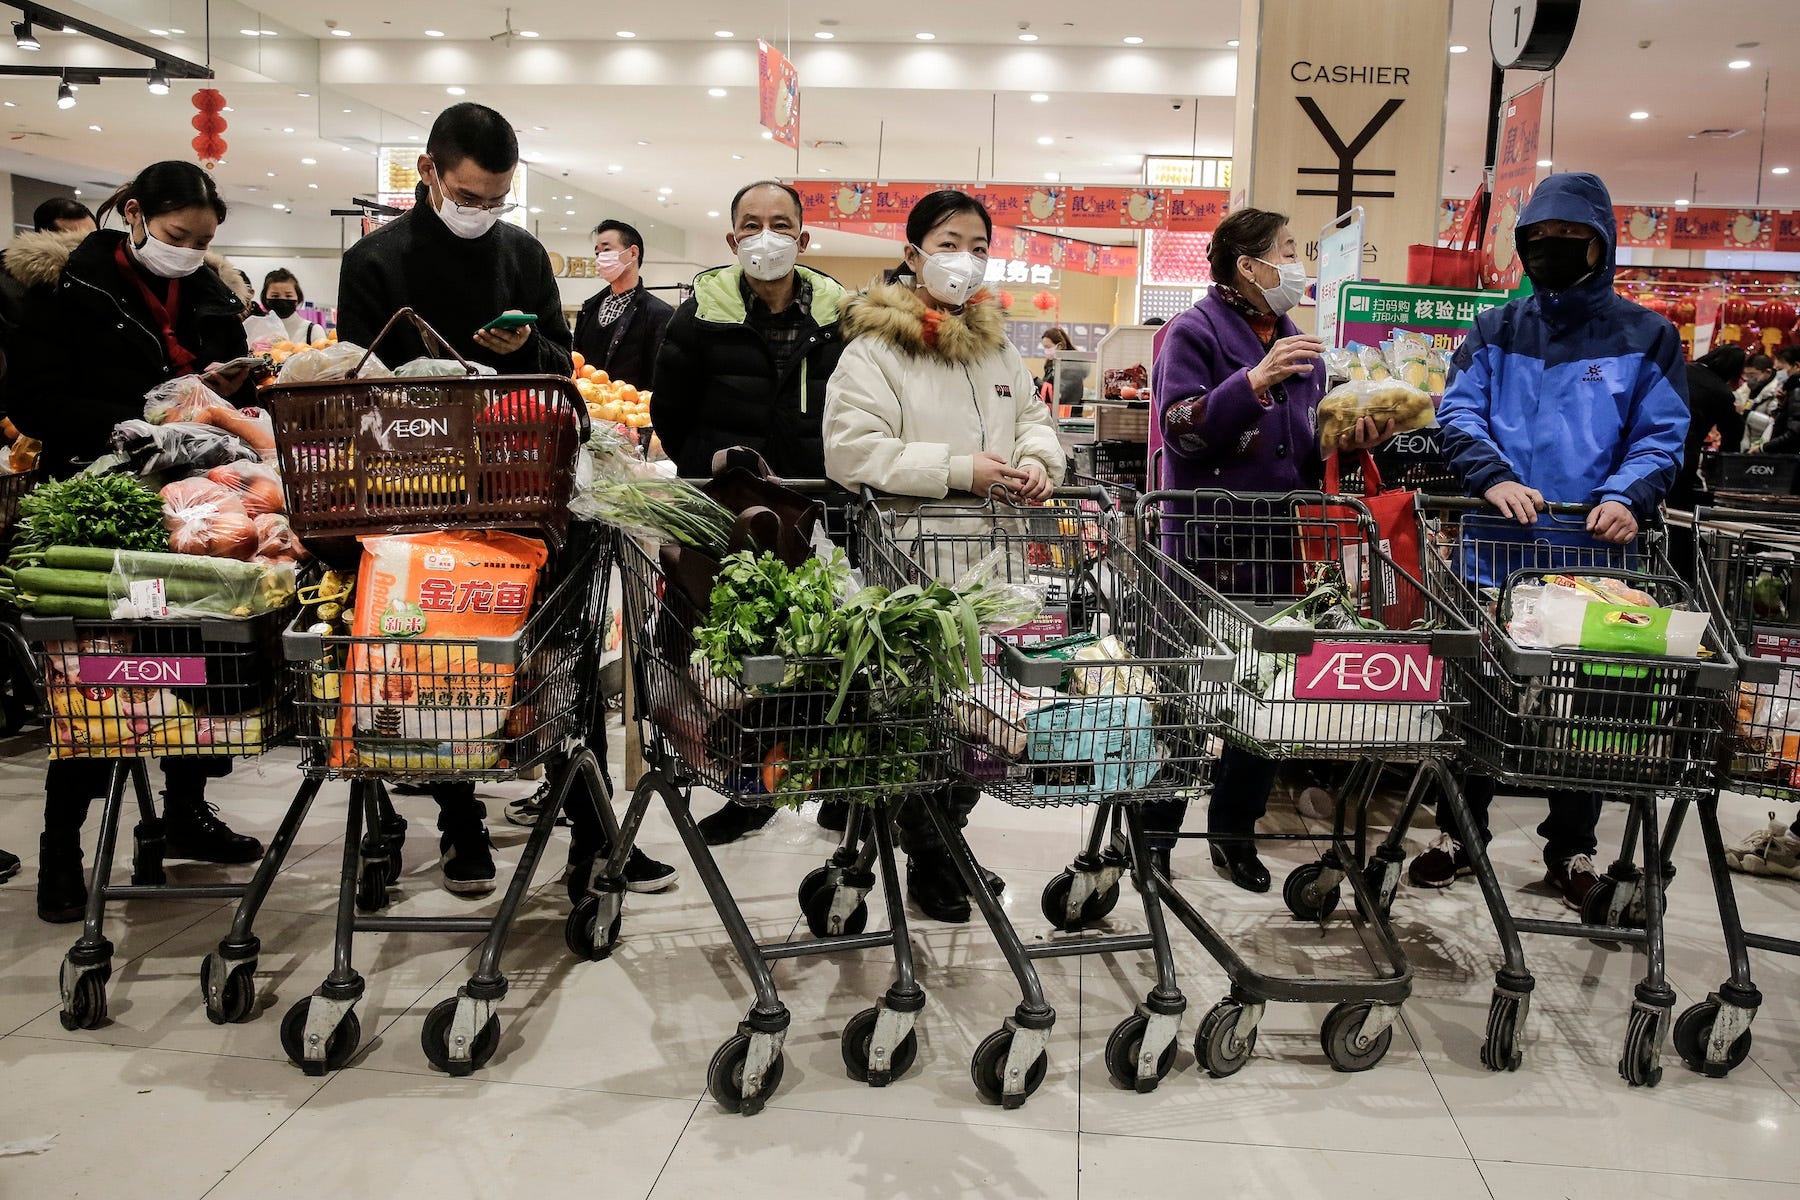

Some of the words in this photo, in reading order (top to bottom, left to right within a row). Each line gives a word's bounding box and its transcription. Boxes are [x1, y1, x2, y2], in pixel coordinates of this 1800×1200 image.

[1514, 6, 1521, 48] 1
[799, 189, 825, 207] 不胜收
[1071, 196, 1117, 213] 鼠不胜收
[1171, 199, 1216, 217] 鼠不胜收
[1674, 215, 1721, 234] 鼠不胜收
[983, 257, 1053, 284] 服务台
[1373, 298, 1411, 312] 扫码购
[1371, 311, 1409, 324] 打印小票
[419, 577, 529, 614] 金龙鱼
[385, 616, 422, 632] 新米
